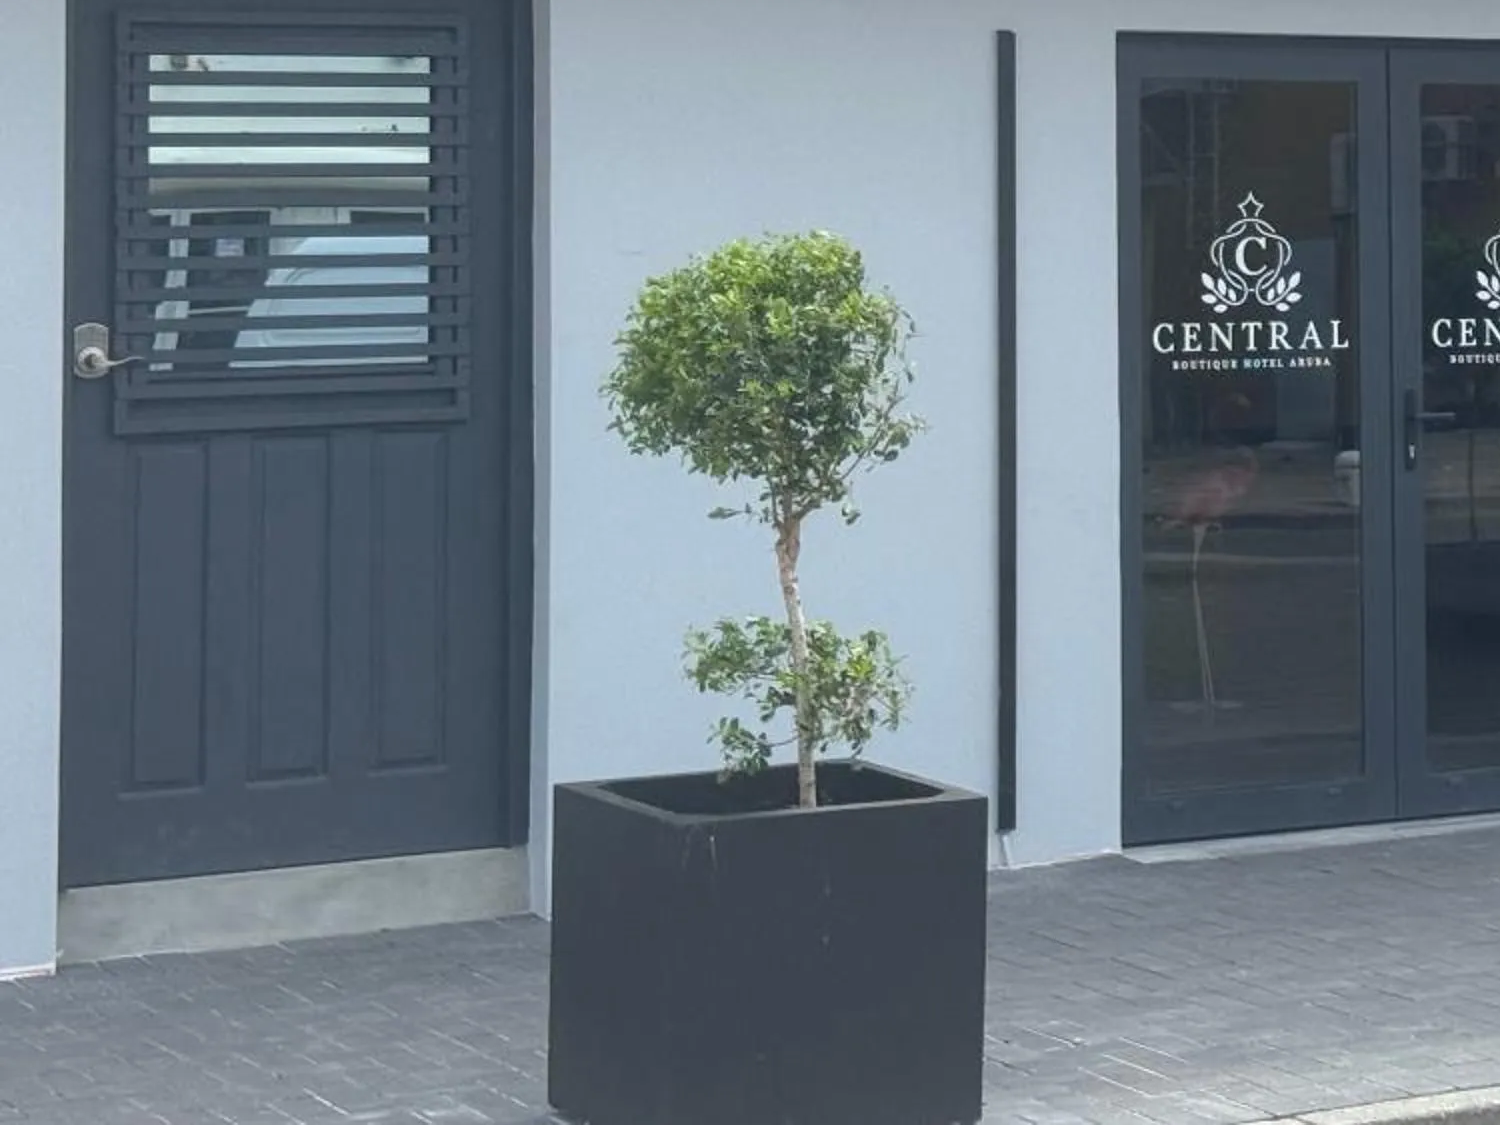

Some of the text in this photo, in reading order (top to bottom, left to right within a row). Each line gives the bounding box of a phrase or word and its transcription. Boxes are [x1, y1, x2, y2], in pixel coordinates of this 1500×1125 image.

[1234, 236, 1267, 276] C
[1152, 319, 1349, 353] CENTRAL
[1172, 357, 1332, 371] BOUTIQUE HOTEL ARUBA
